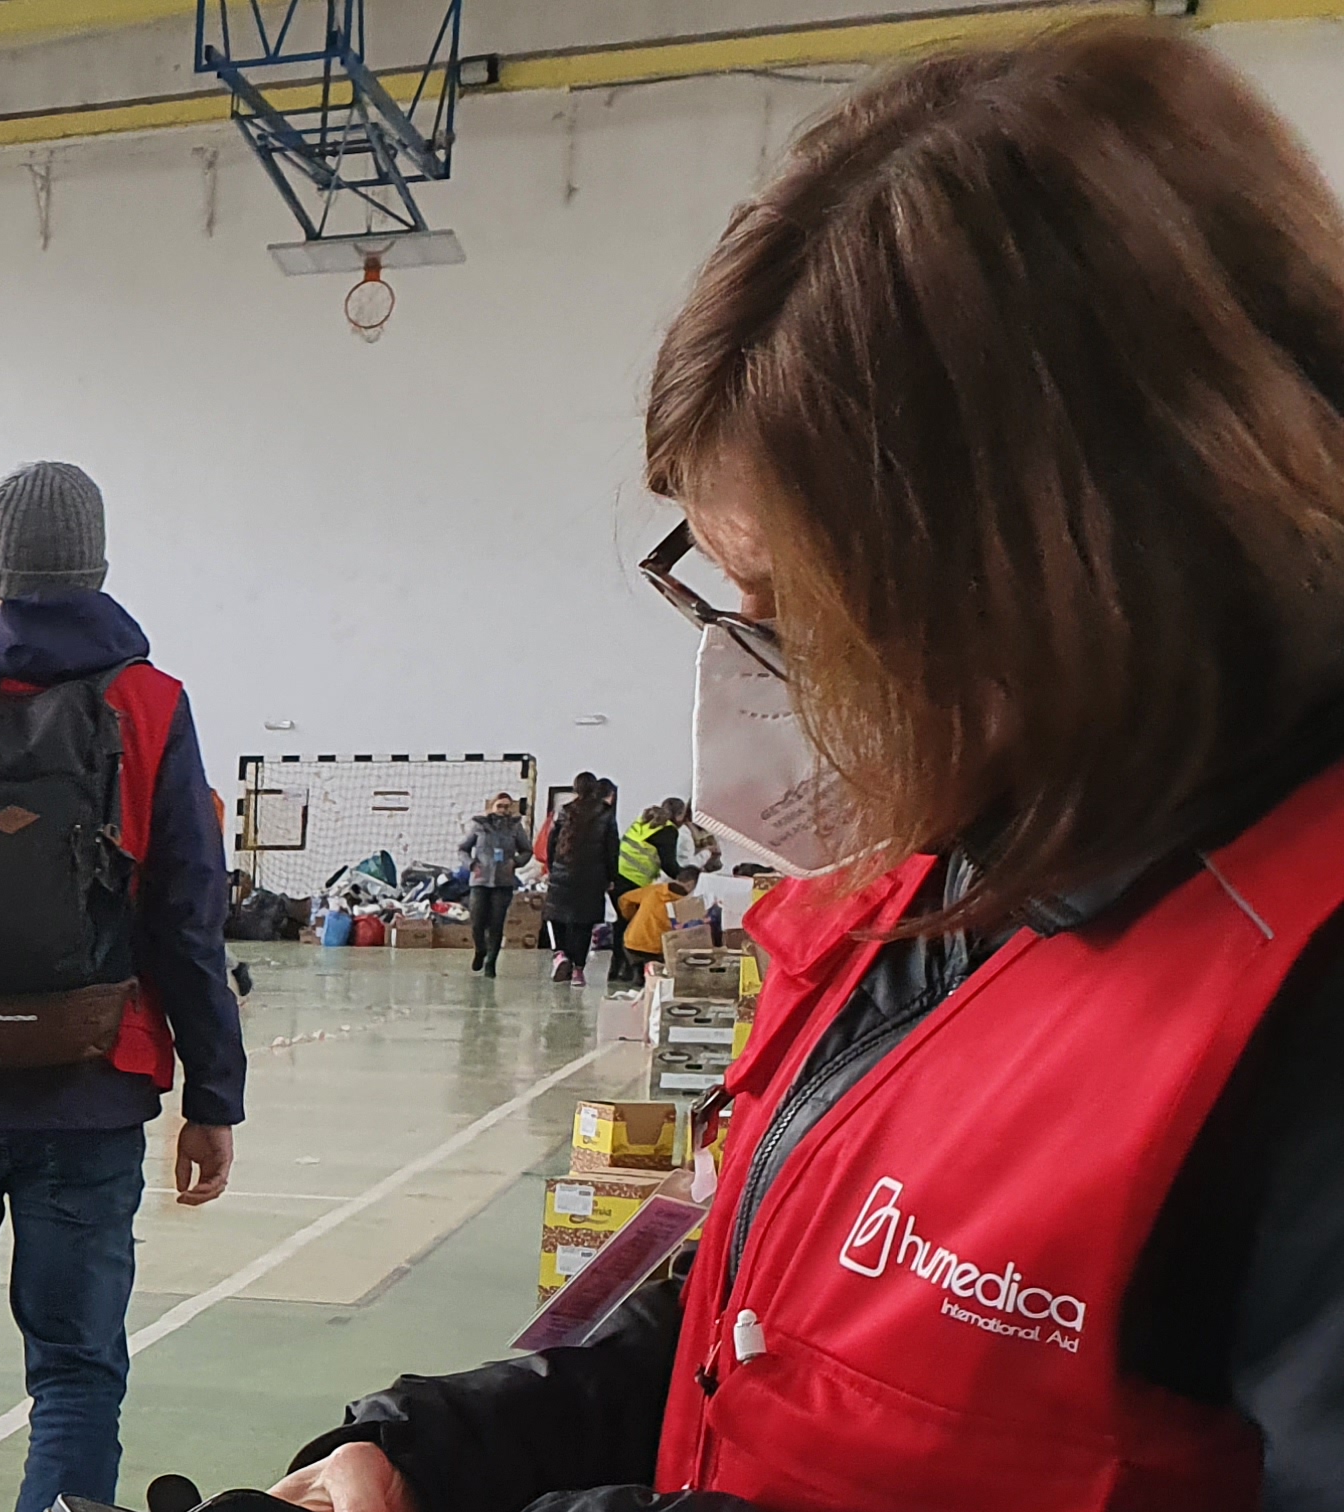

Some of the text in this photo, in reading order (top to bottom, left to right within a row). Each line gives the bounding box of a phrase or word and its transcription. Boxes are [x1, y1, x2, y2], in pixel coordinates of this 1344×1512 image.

[896, 1215, 1086, 1332] humedica
[940, 1298, 1080, 1353] International Aid
